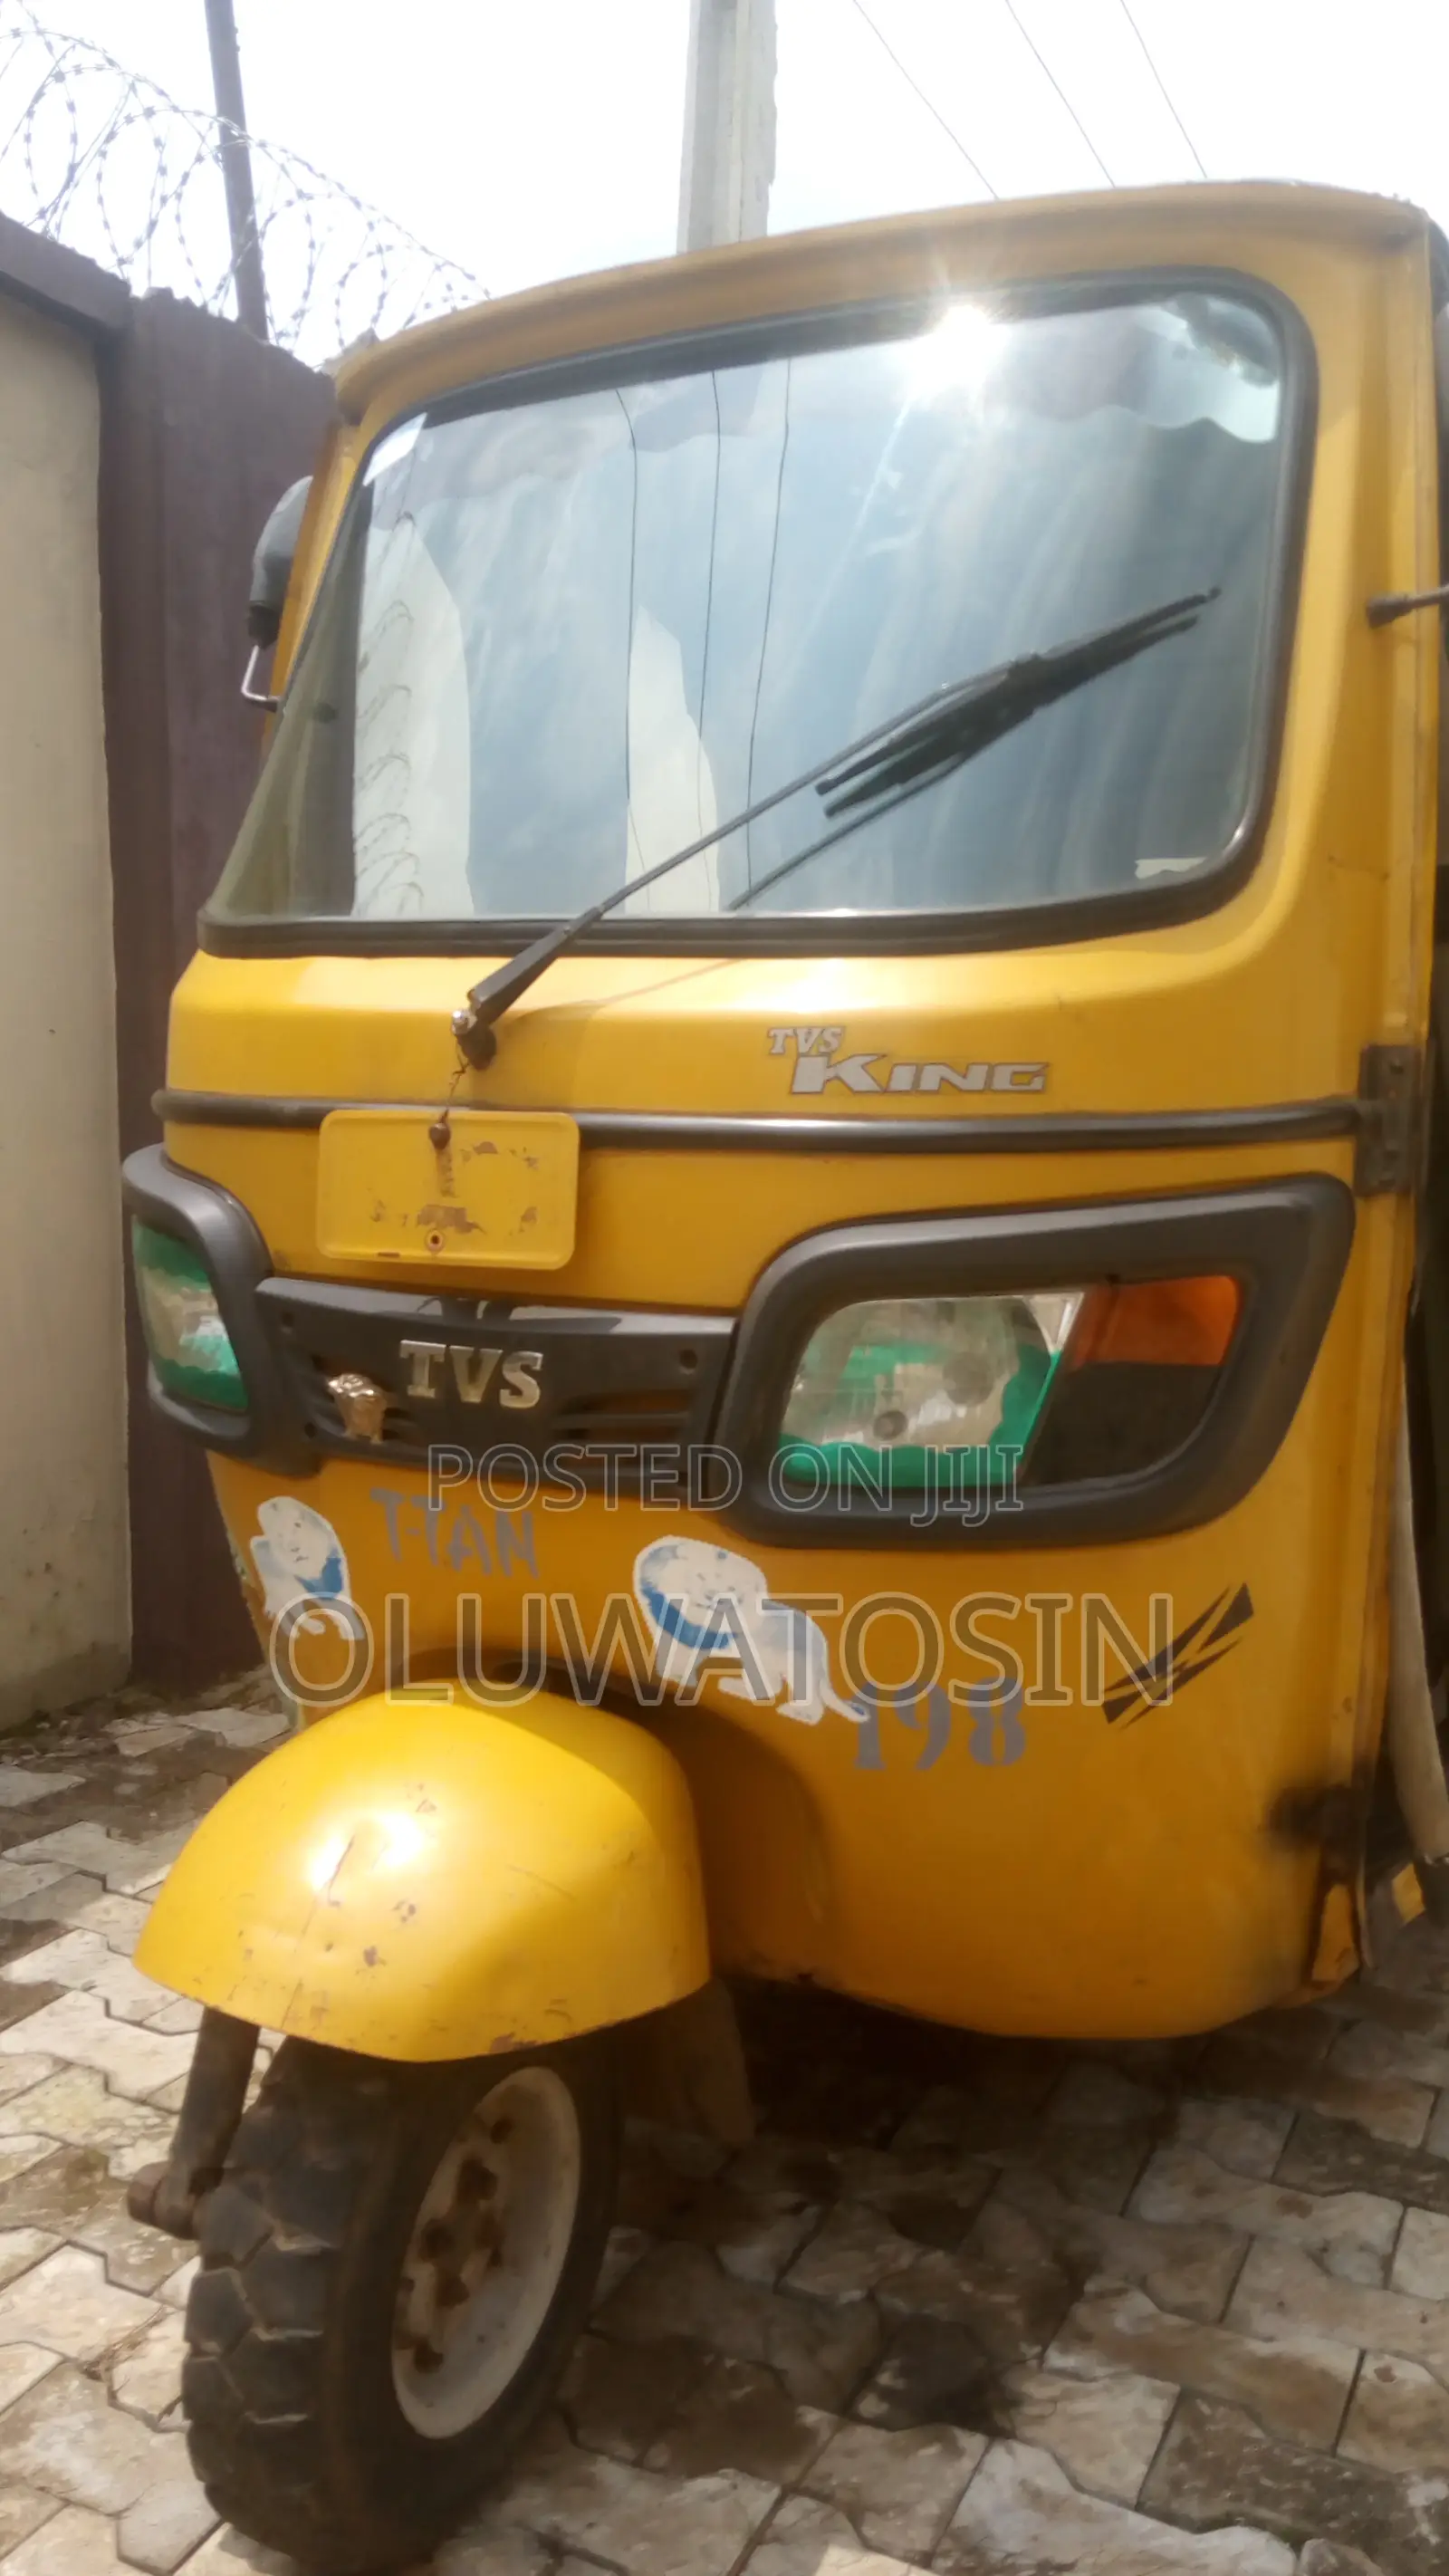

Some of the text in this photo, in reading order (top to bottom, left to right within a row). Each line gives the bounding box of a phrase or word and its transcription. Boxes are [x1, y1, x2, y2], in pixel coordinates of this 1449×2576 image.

[768, 1026, 846, 1054] TVS
[791, 1053, 1049, 1094] KING
[399, 1340, 543, 1408] TVS
[850, 1677, 1027, 1771] 198
